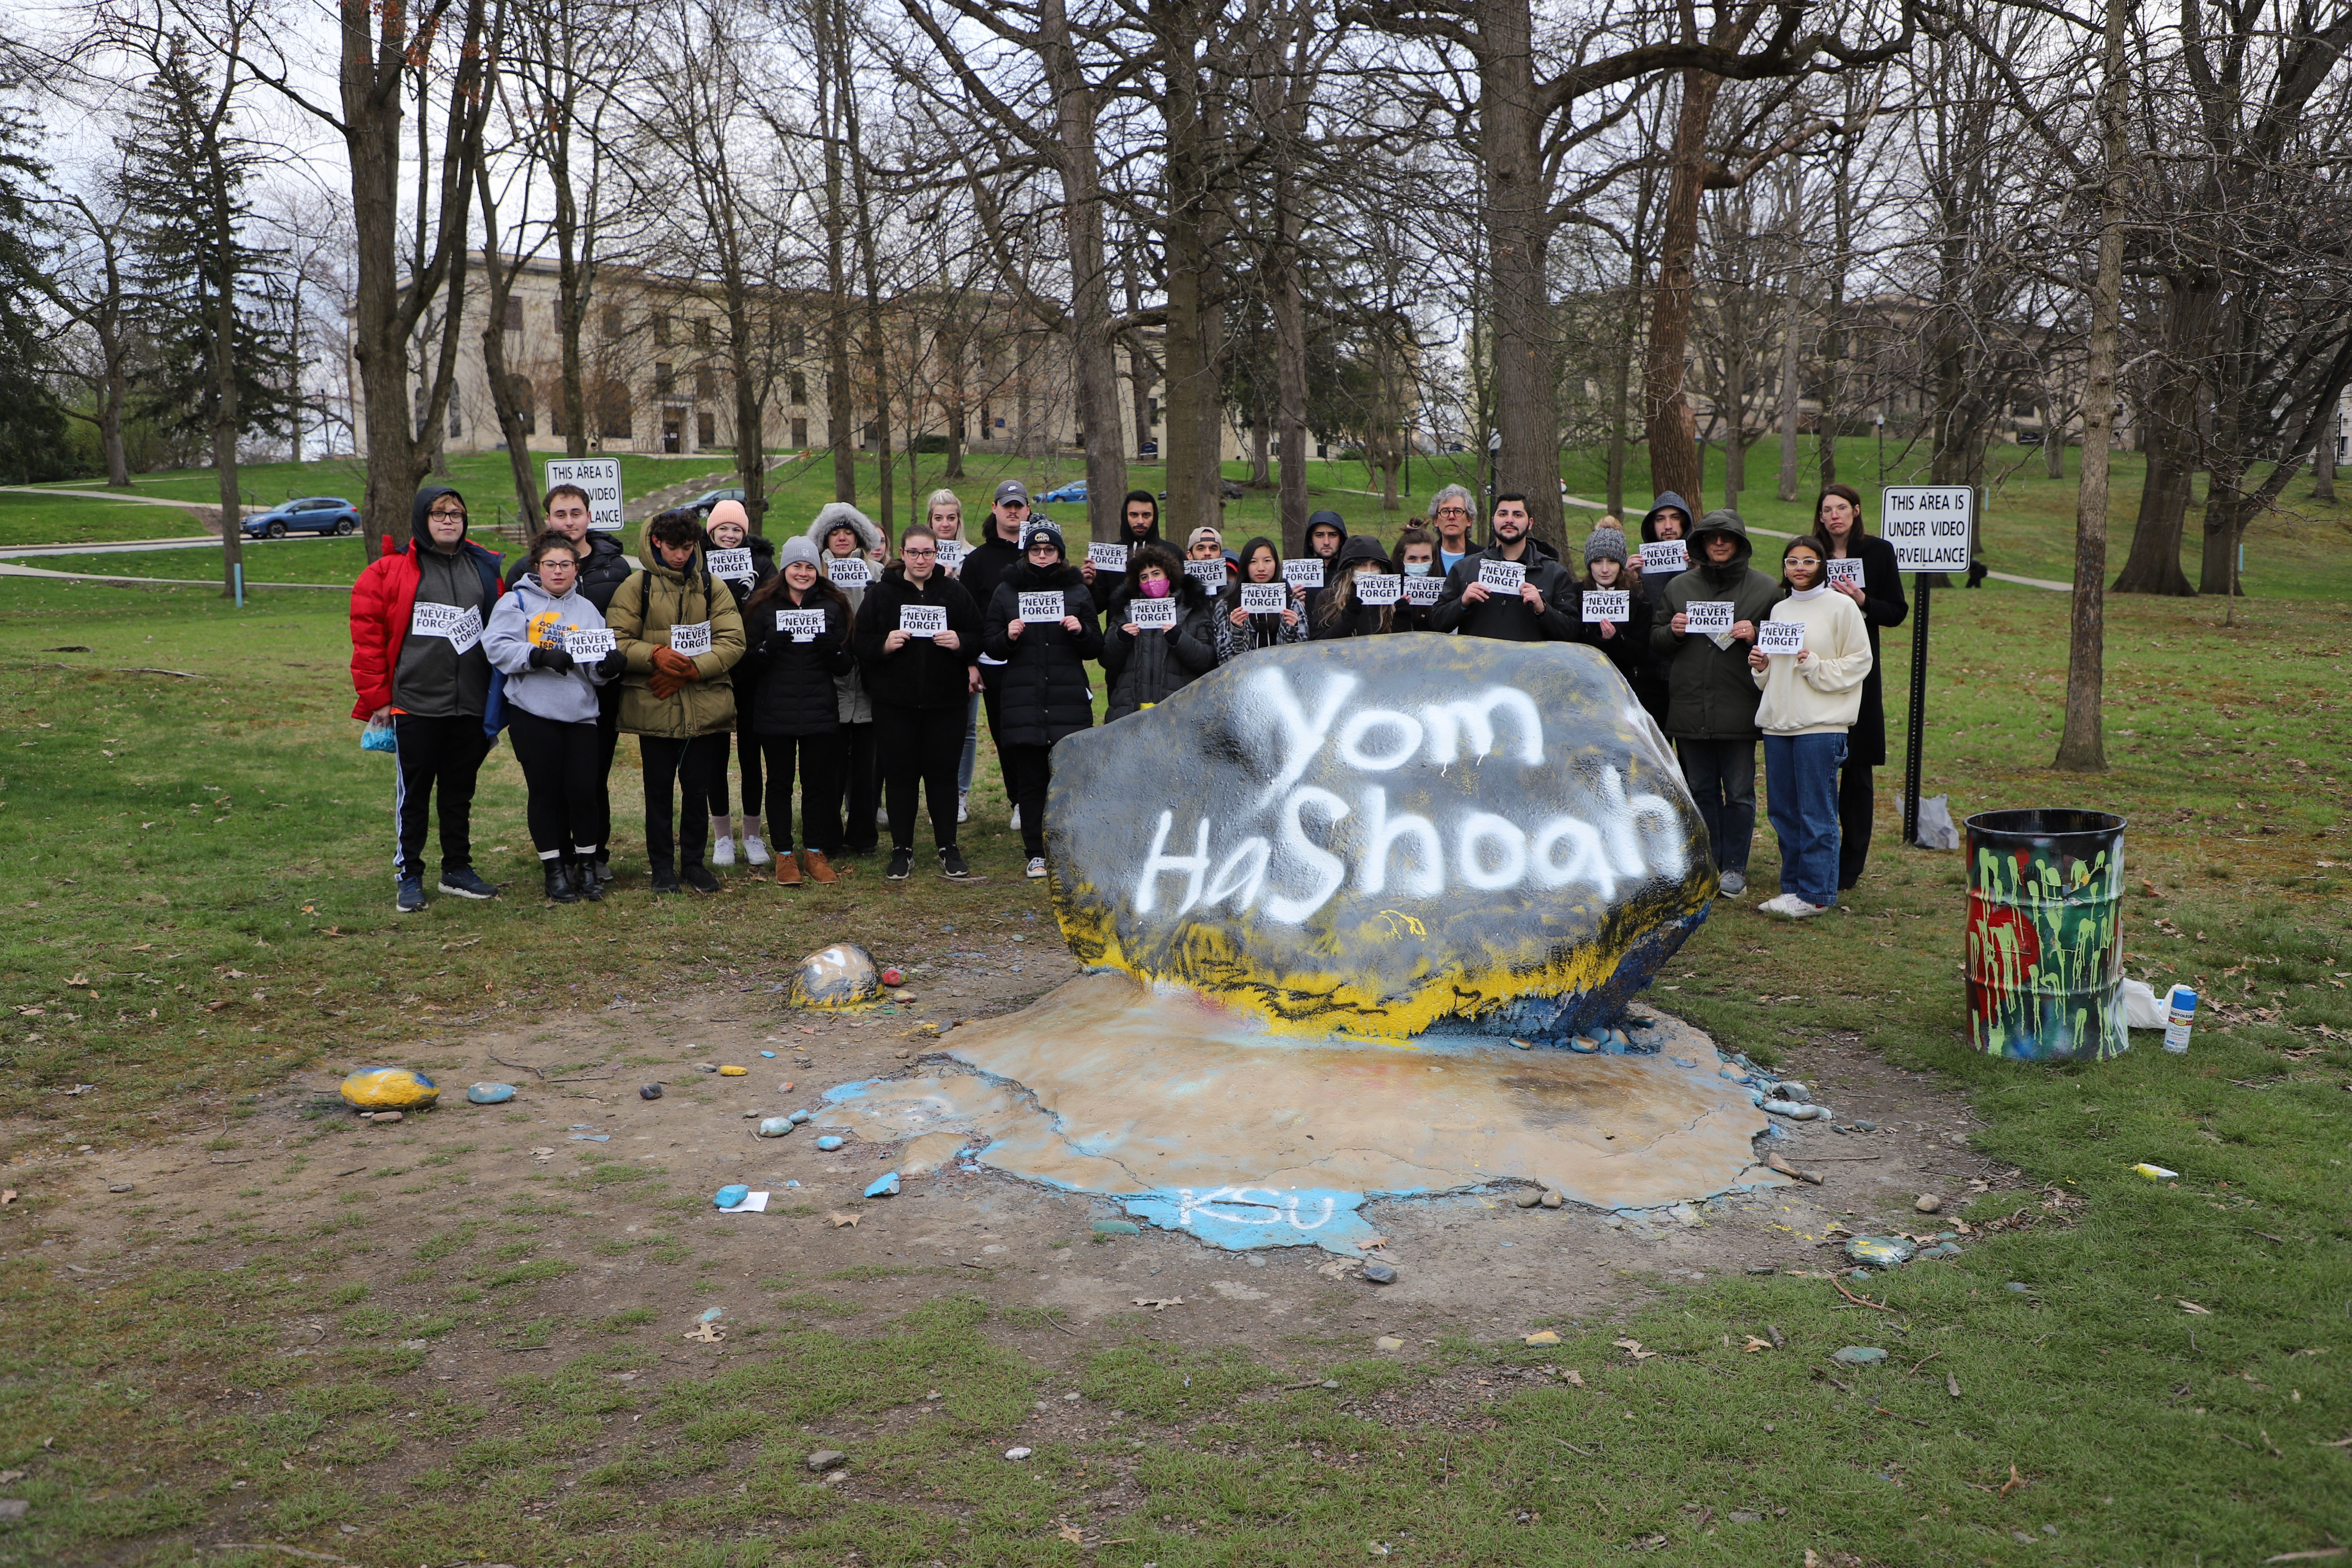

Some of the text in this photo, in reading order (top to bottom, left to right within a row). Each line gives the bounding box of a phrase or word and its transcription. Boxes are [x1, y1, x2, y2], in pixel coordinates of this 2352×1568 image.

[553, 466, 613, 479] THIS AREA IS
[588, 487, 616, 500] VIDEO
[1891, 495, 1964, 510] THIS AREA IS
[1889, 521, 1965, 536] UNDER VIDEO
[1094, 548, 1121, 557] NEVER
[1647, 548, 1678, 558] NEVER
[1896, 548, 1965, 562] RVEILLANCE
[714, 554, 745, 564] NEVER
[1091, 555, 1124, 565] FORGET
[1645, 556, 1682, 567] FORGET
[711, 562, 749, 573] FORGET
[1190, 564, 1220, 573] NEVER
[1486, 566, 1518, 578] NEVER
[1828, 565, 1853, 574] EVER
[832, 572, 868, 580] FORGET
[1193, 572, 1223, 581] RGET
[1482, 574, 1521, 587] FORGET
[1828, 574, 1857, 583] RGET
[1025, 597, 1057, 606] NEVER
[1023, 606, 1061, 615] FORGET
[1138, 604, 1169, 613] NEVER
[1586, 606, 1625, 614] FORGET
[420, 609, 456, 620] NEVER
[907, 612, 939, 620] NEVER
[1135, 612, 1172, 621] FORGET
[416, 618, 448, 628] FORG
[452, 614, 478, 635] NEVER
[540, 621, 572, 631] GOLDEN
[786, 617, 818, 626] NEVER
[903, 621, 942, 629] FORGET
[1689, 617, 1730, 625] FORGET
[454, 622, 482, 645] FORGET
[539, 627, 563, 637] FLASH
[678, 628, 706, 639] NEVER
[1765, 628, 1797, 636] NEVER
[547, 635, 563, 644] FOR
[572, 635, 608, 645] NEVER
[675, 636, 708, 649] FORGET
[1761, 637, 1800, 646] FORGET
[540, 641, 564, 650] ISRAE
[570, 644, 612, 655] FORGET
[1250, 666, 1545, 807] Yom
[1136, 764, 1686, 924] HaShoah
[1176, 1187, 1334, 1230] KSU
